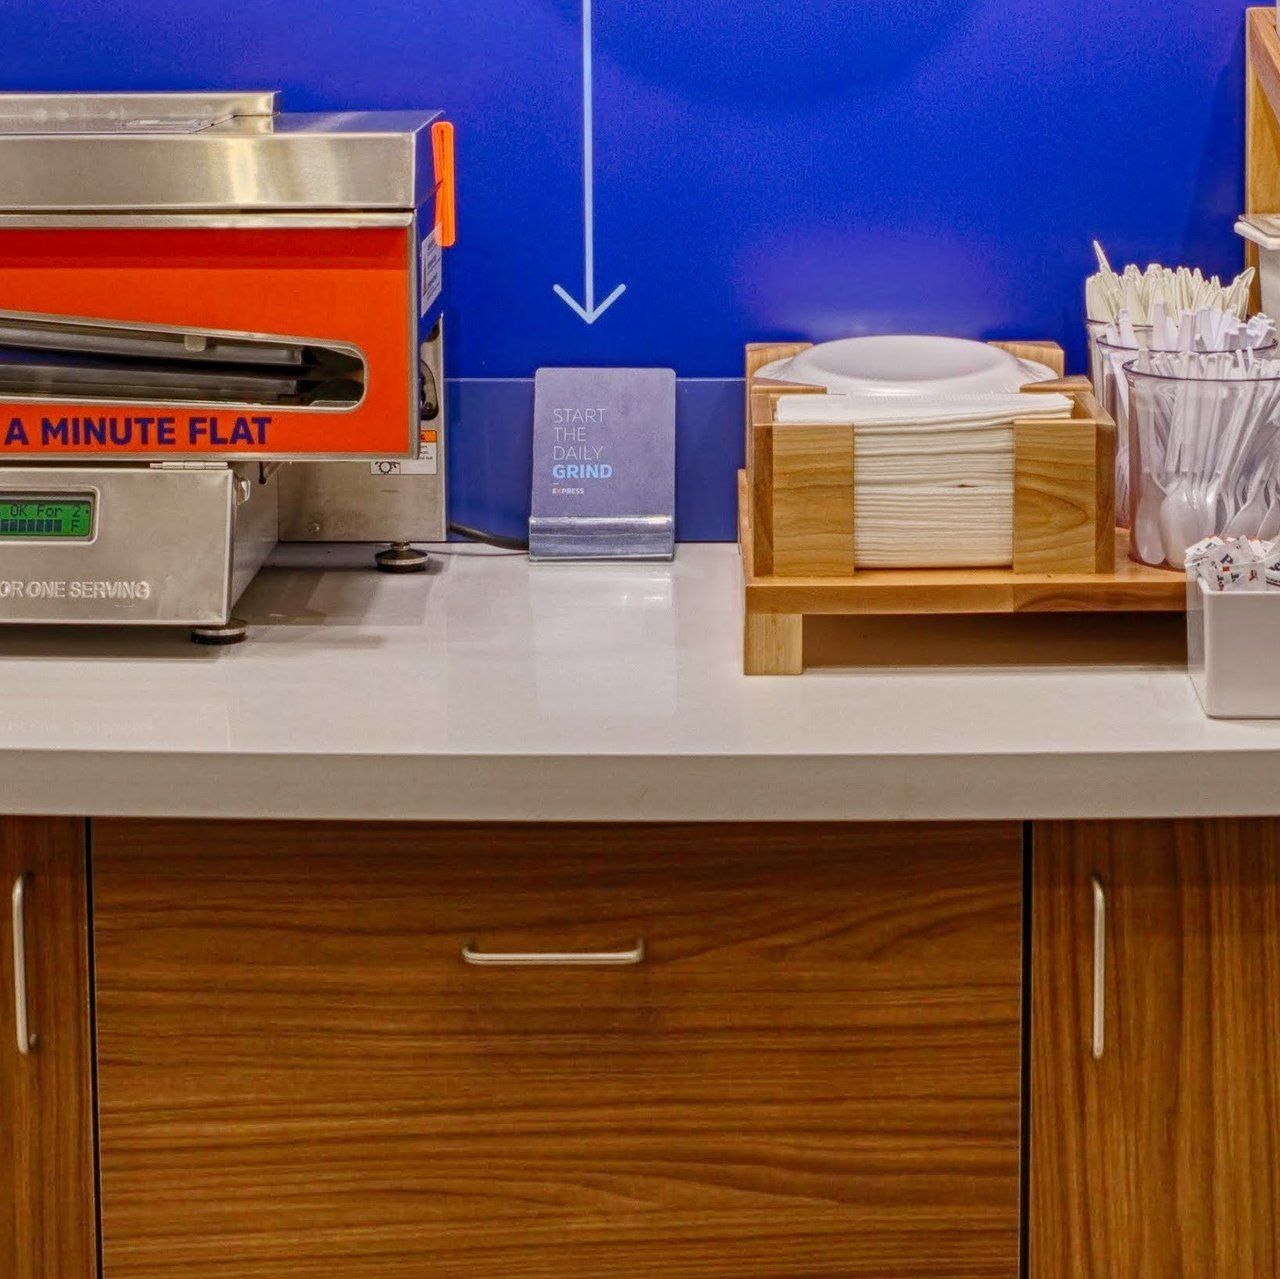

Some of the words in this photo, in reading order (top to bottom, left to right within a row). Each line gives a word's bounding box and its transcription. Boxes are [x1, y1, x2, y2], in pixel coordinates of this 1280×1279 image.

[553, 408, 607, 423] START
[3, 417, 29, 445] A
[41, 417, 176, 446] MINUTE
[188, 417, 272, 445] FLAT
[553, 426, 587, 441] THE
[553, 445, 604, 461] DAILY
[552, 464, 613, 479] GRIND
[552, 487, 585, 495] EXPRESS
[10, 504, 28, 517] OK
[26, 580, 66, 599] ONE
[70, 580, 152, 599] SERVING
